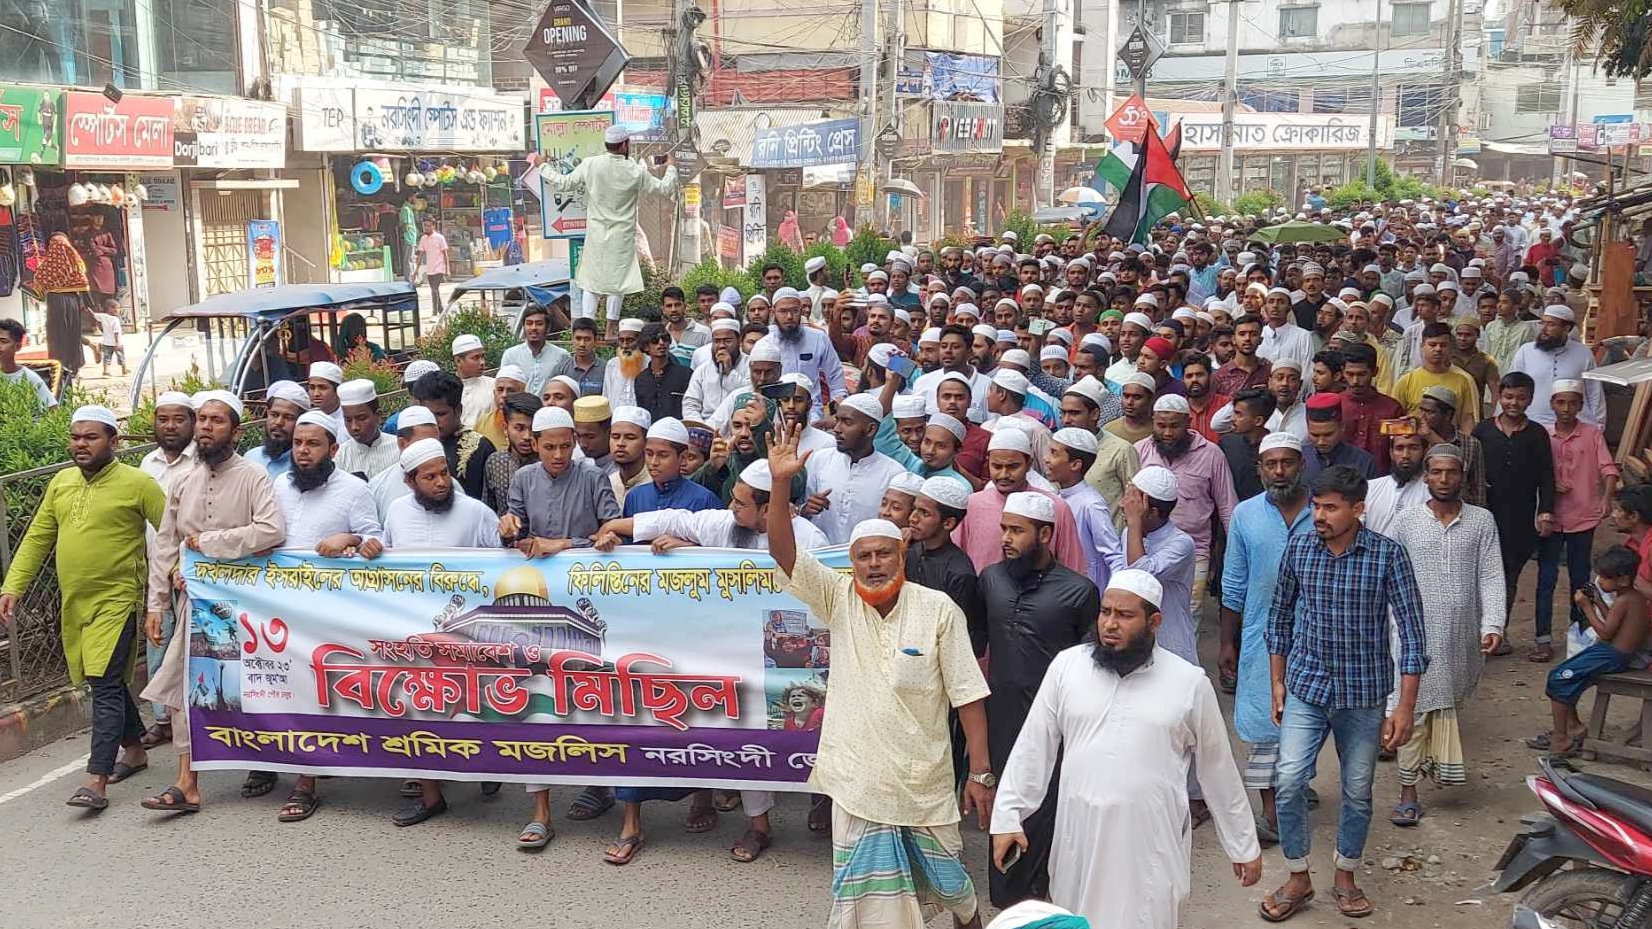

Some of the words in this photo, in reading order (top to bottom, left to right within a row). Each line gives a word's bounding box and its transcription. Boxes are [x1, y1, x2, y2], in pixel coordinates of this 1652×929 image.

[543, 25, 587, 44] OPENING
[70, 102, 129, 147] স্পোর্টস
[134, 116, 170, 149] মেলা
[381, 97, 421, 132] নরসিংদী
[425, 101, 457, 131] স্পোর্টস
[1273, 118, 1362, 144] ক্রোকারিজ
[758, 130, 781, 158] রনি
[784, 127, 823, 158] প্রিন্টিং
[827, 128, 856, 155] প্রেস
[264, 560, 346, 591] ইসরাইলের
[349, 566, 425, 592] আগ্রাসনের
[568, 561, 653, 596] ফিলিস্তিনের
[656, 568, 712, 601] মজলুম
[239, 612, 289, 654] ১৩
[242, 656, 275, 670] অক্টোবর
[368, 637, 436, 662] সংহতি
[437, 640, 519, 664] সমাবেশ
[523, 642, 541, 664] ও
[247, 673, 262, 684] বাদ
[308, 642, 532, 718] বিক্ষোভ
[544, 649, 743, 731] মিছিল
[205, 725, 370, 754] বাংলাদেশ
[381, 730, 484, 760] শ্রমিক
[493, 735, 630, 765] মজলিস
[640, 743, 778, 769] নরসিংদী
